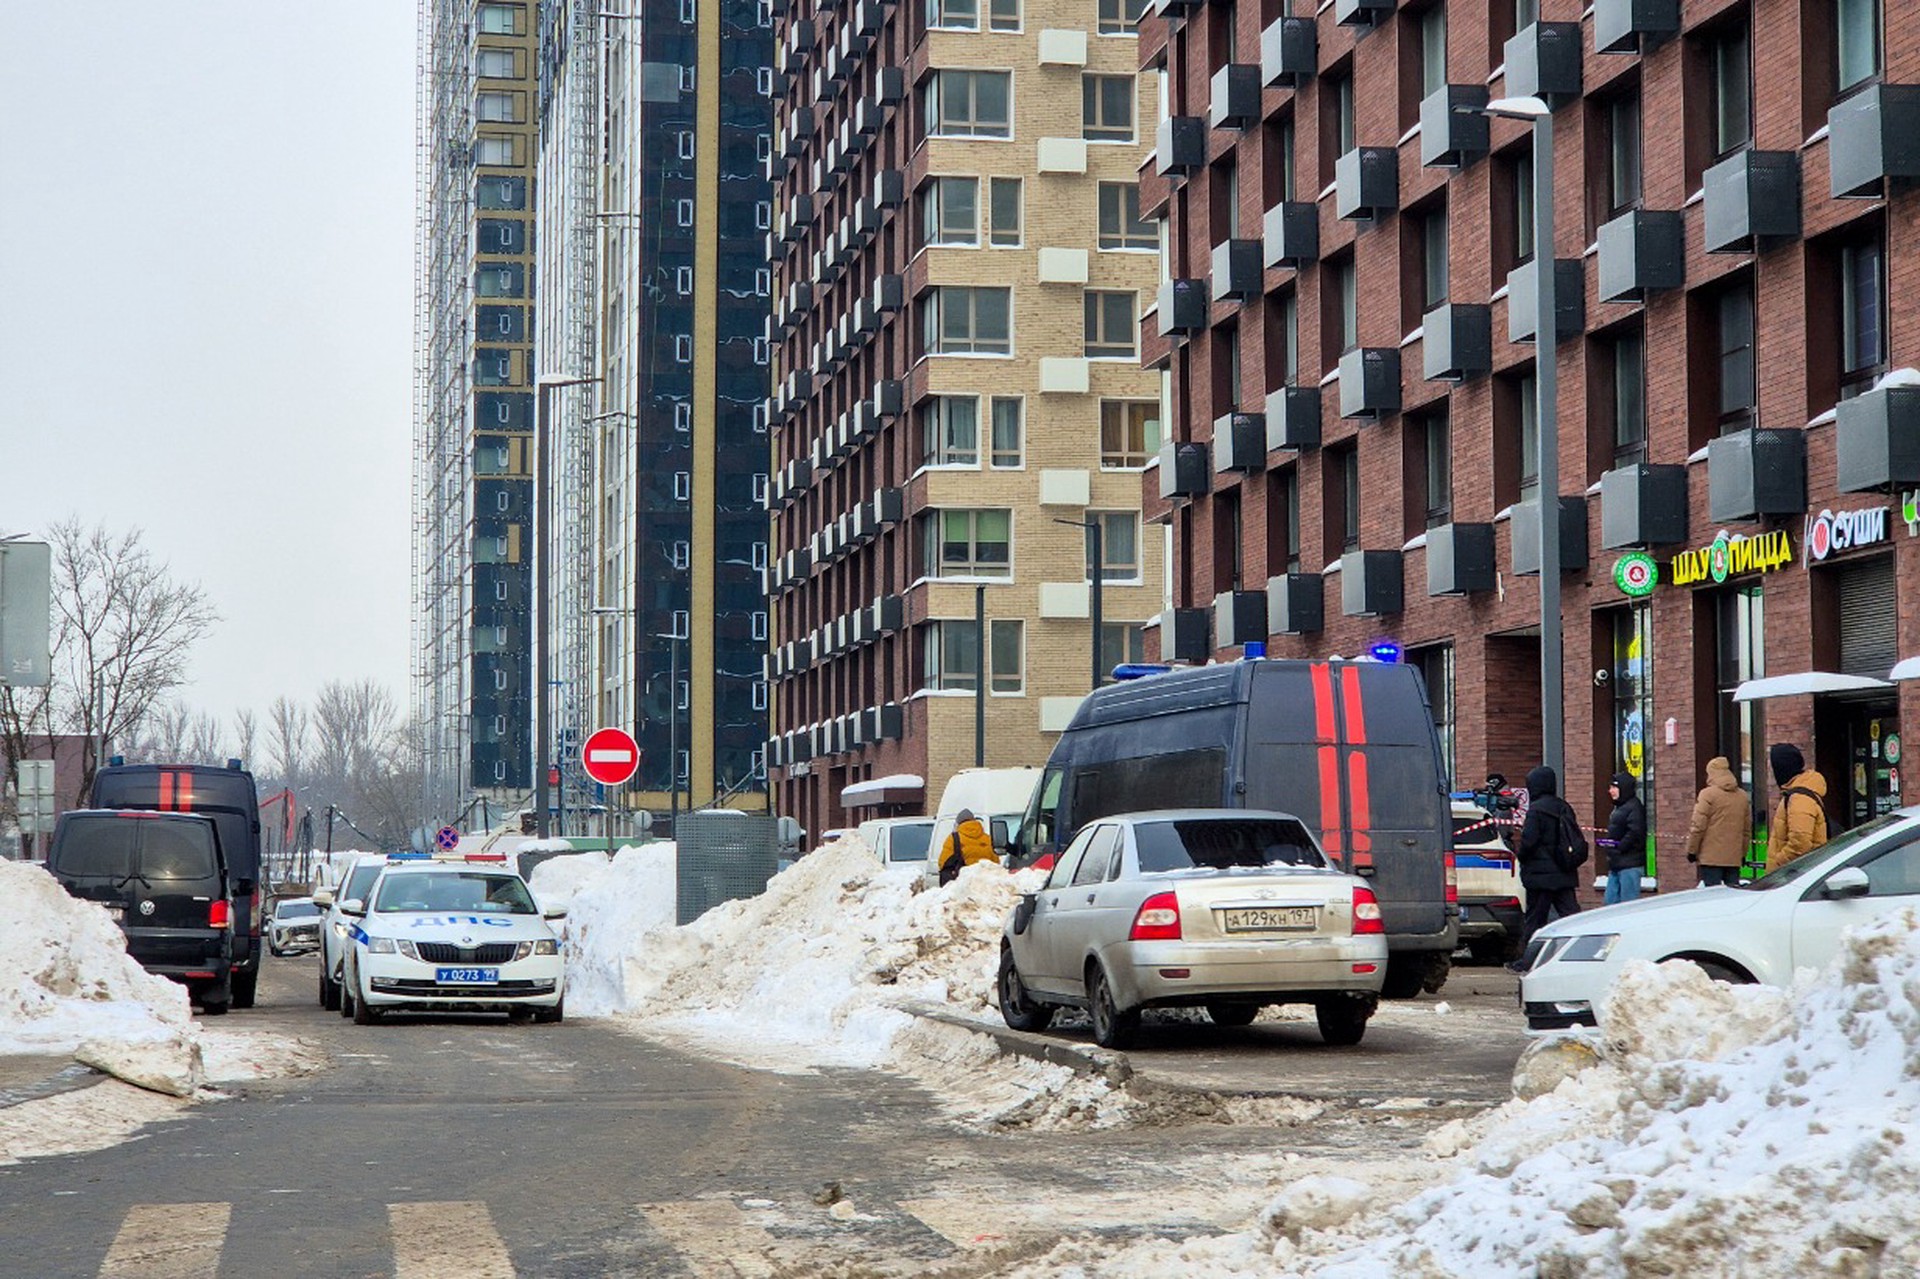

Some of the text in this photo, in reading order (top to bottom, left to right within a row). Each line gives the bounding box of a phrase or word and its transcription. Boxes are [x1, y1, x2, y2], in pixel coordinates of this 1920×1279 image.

[1831, 510, 1884, 549] СУШИ
[1672, 547, 1710, 585] ШАУ
[1728, 530, 1792, 574] ПИЦЦА
[410, 916, 513, 928] ДПС
